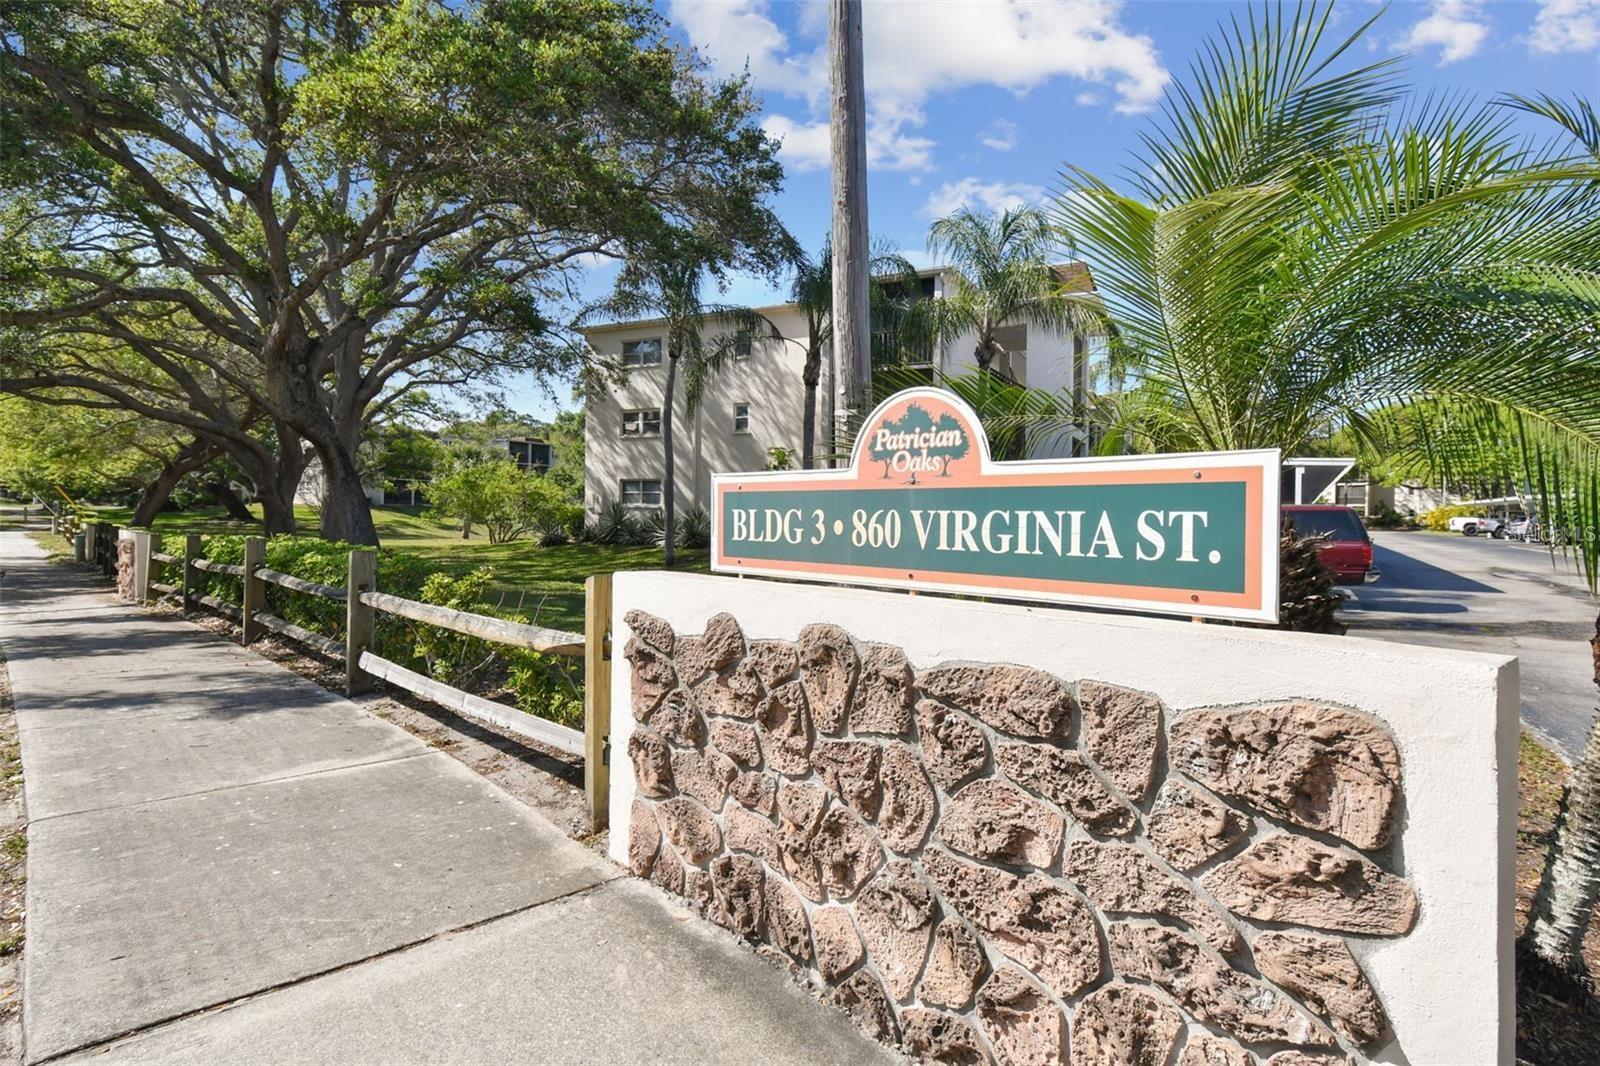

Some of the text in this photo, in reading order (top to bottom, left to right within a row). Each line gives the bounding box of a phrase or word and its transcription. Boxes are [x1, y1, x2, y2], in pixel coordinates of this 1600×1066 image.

[874, 425, 963, 452] Patrician
[892, 449, 941, 473] Oaks
[731, 508, 1222, 565] BLDG 3 860 VIRGINIA ST.
